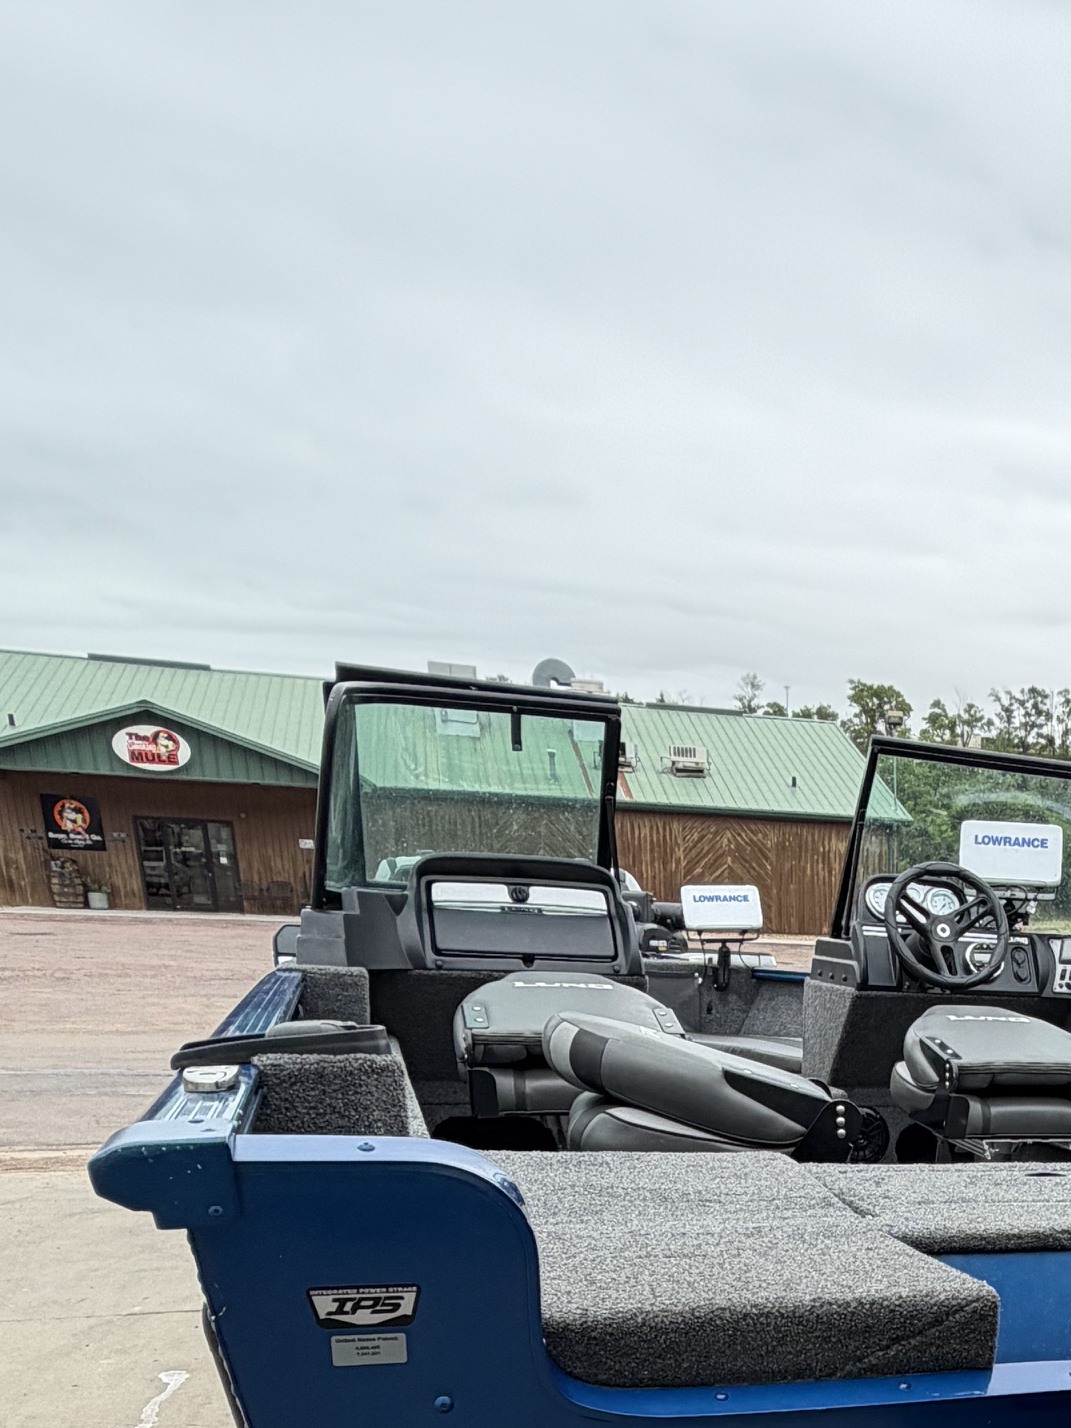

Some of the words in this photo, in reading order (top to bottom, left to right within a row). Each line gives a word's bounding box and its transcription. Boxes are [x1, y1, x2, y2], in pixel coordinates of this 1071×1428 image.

[131, 750, 178, 763] MULE
[974, 834, 1049, 849] LOWRANCE
[693, 895, 750, 903] LOWRANCE
[325, 1295, 405, 1316] IPS
